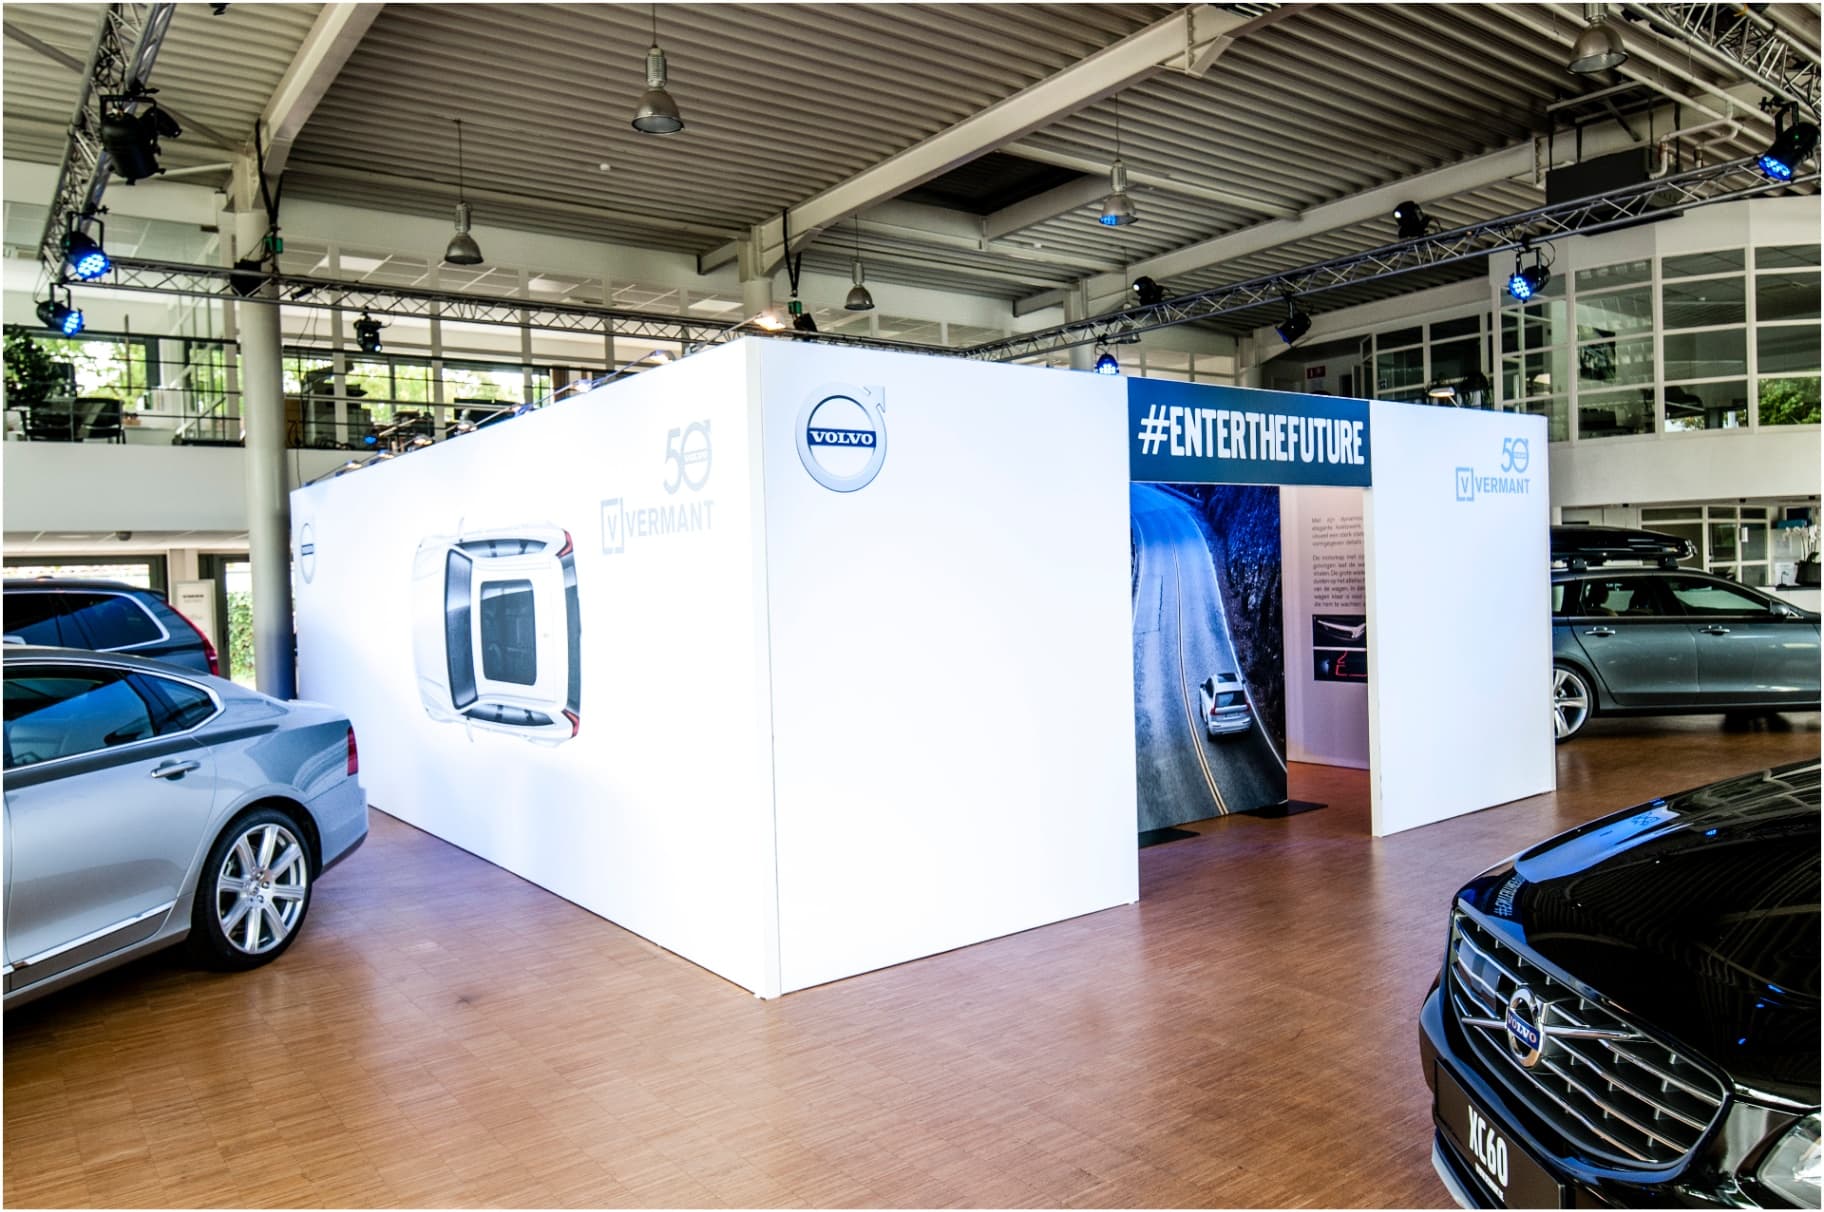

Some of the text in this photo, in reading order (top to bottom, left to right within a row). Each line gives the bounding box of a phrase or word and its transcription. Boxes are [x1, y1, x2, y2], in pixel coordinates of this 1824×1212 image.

[809, 431, 873, 445] VOLVO
[1138, 404, 1365, 465] #ENTERTHEFUTURE
[1501, 437, 1529, 473] 50
[1475, 477, 1530, 494] VERMANT
[625, 499, 714, 537] VERMANT
[1507, 1014, 1537, 1044] VOLVO
[1468, 1105, 1508, 1187] XC60
